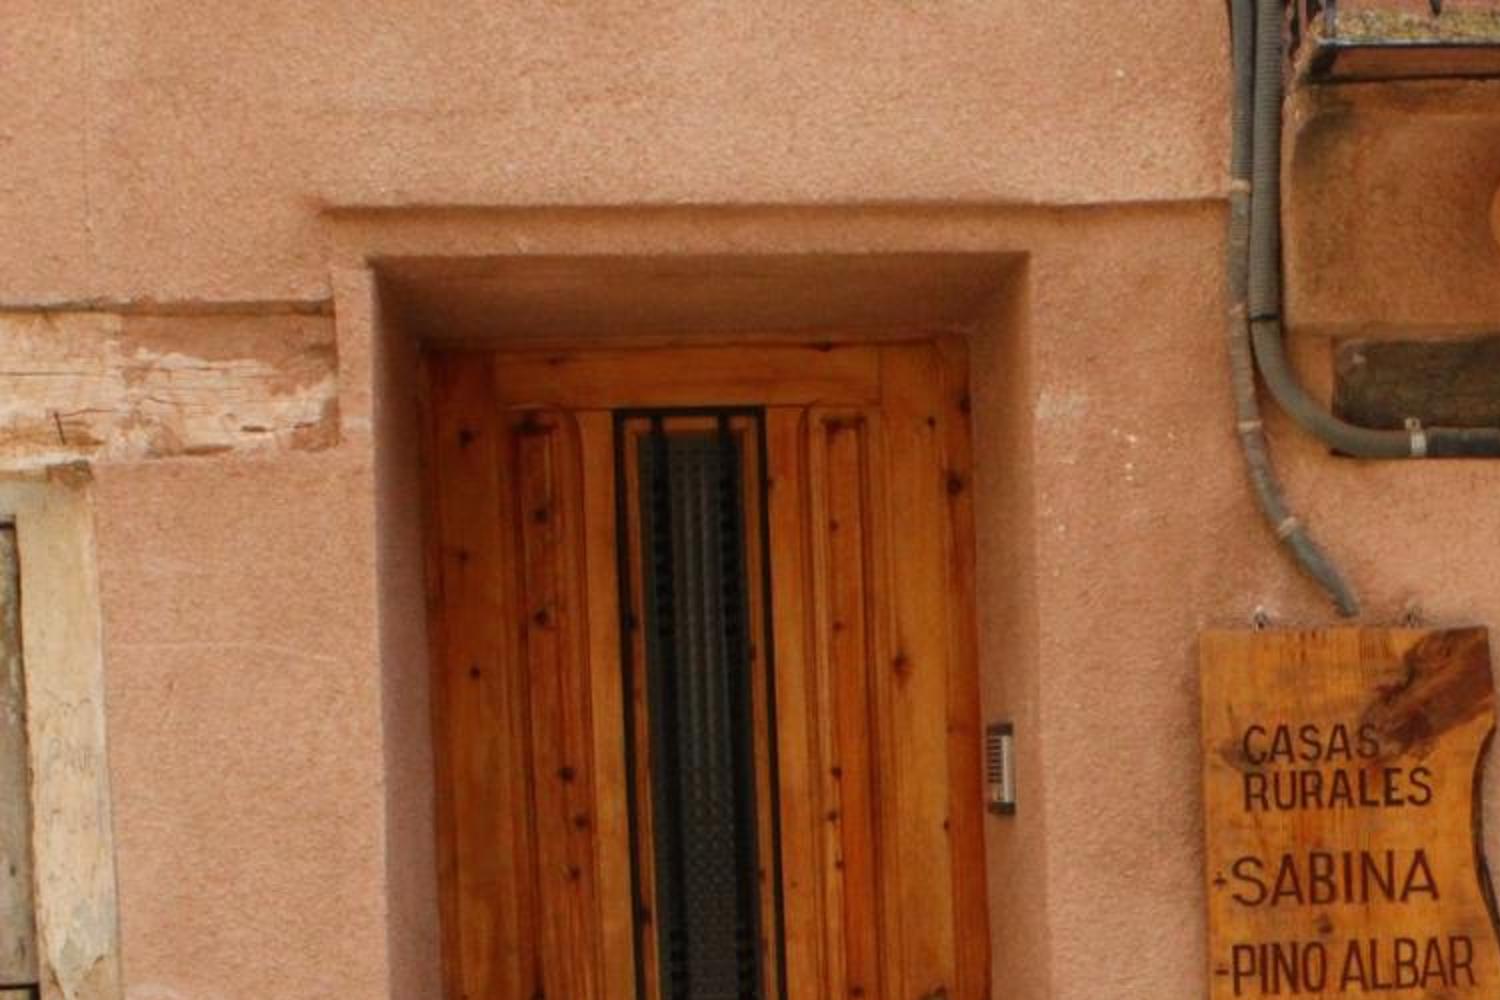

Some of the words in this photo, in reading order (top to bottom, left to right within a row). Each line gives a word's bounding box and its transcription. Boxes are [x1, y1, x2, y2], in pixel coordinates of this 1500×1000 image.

[1242, 723, 1379, 766] CASAS
[1243, 767, 1433, 812] RURALES
[1339, 935, 1476, 993] ALBAR
